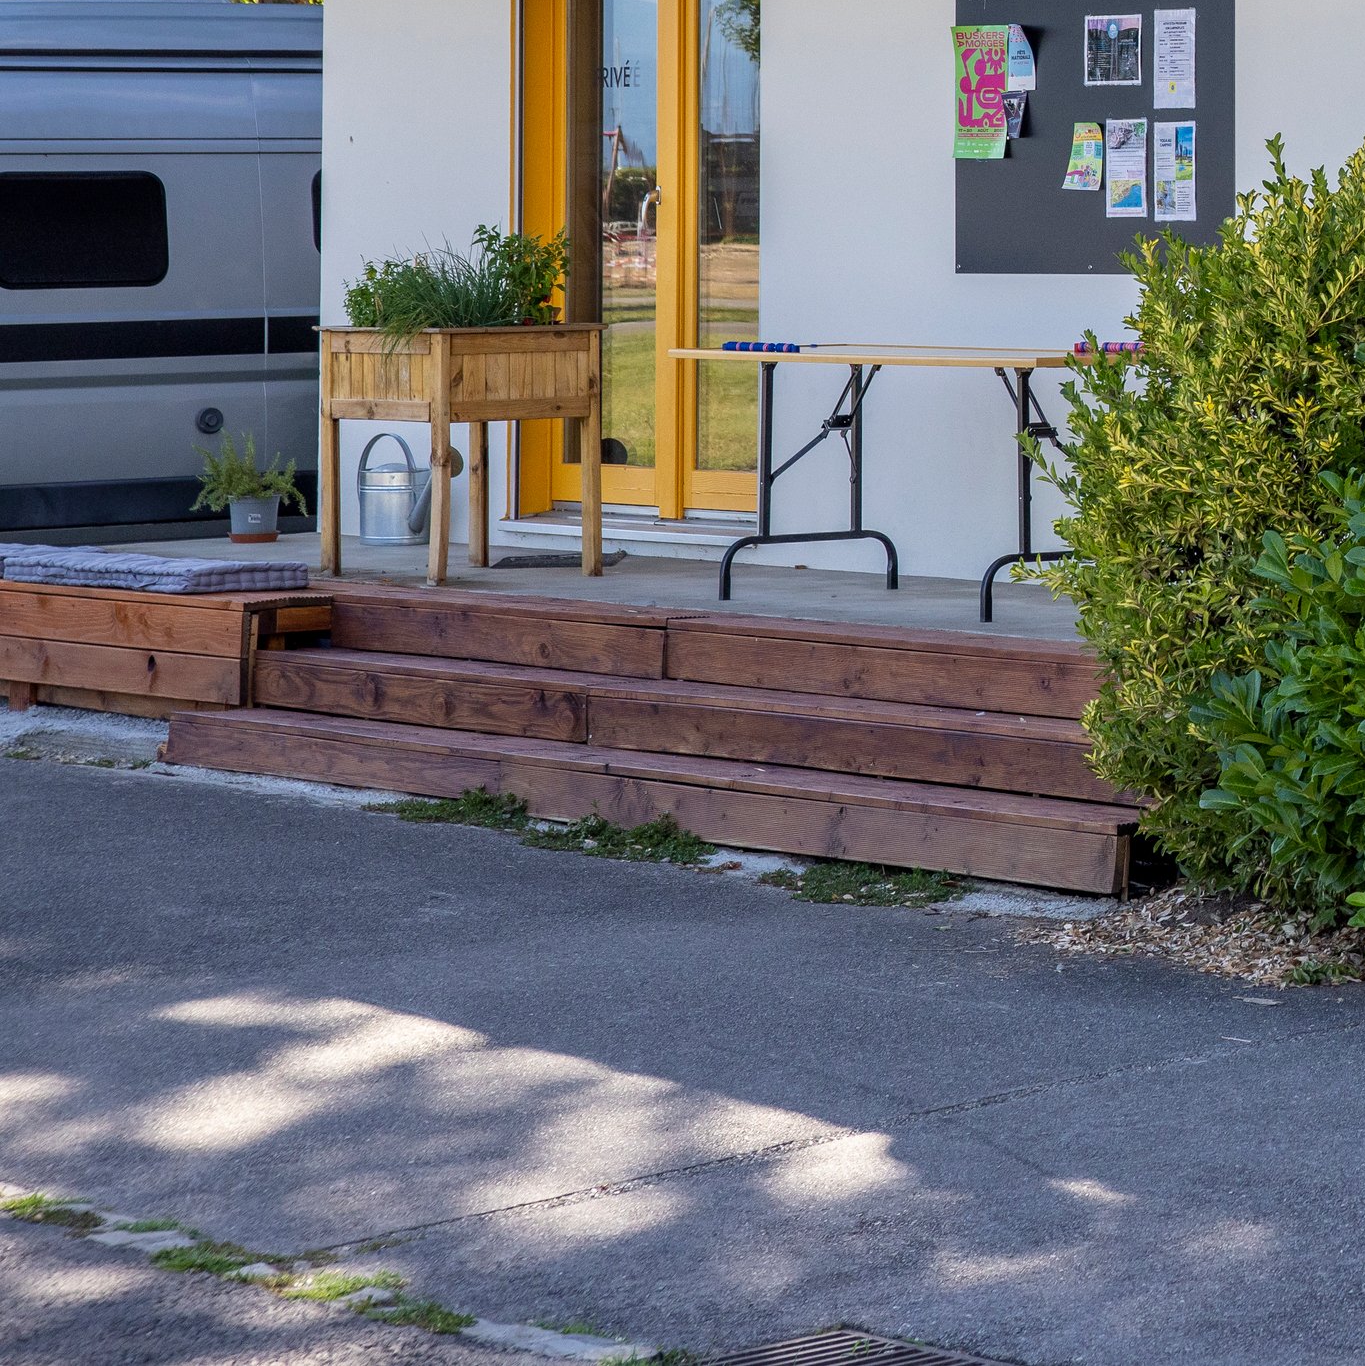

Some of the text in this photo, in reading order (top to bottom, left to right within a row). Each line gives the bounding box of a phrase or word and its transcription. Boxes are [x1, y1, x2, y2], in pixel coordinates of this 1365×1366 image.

[956, 31, 1005, 40] BUSKERS
[965, 39, 1005, 47] MORGES
[600, 59, 630, 88] RIVÉ
